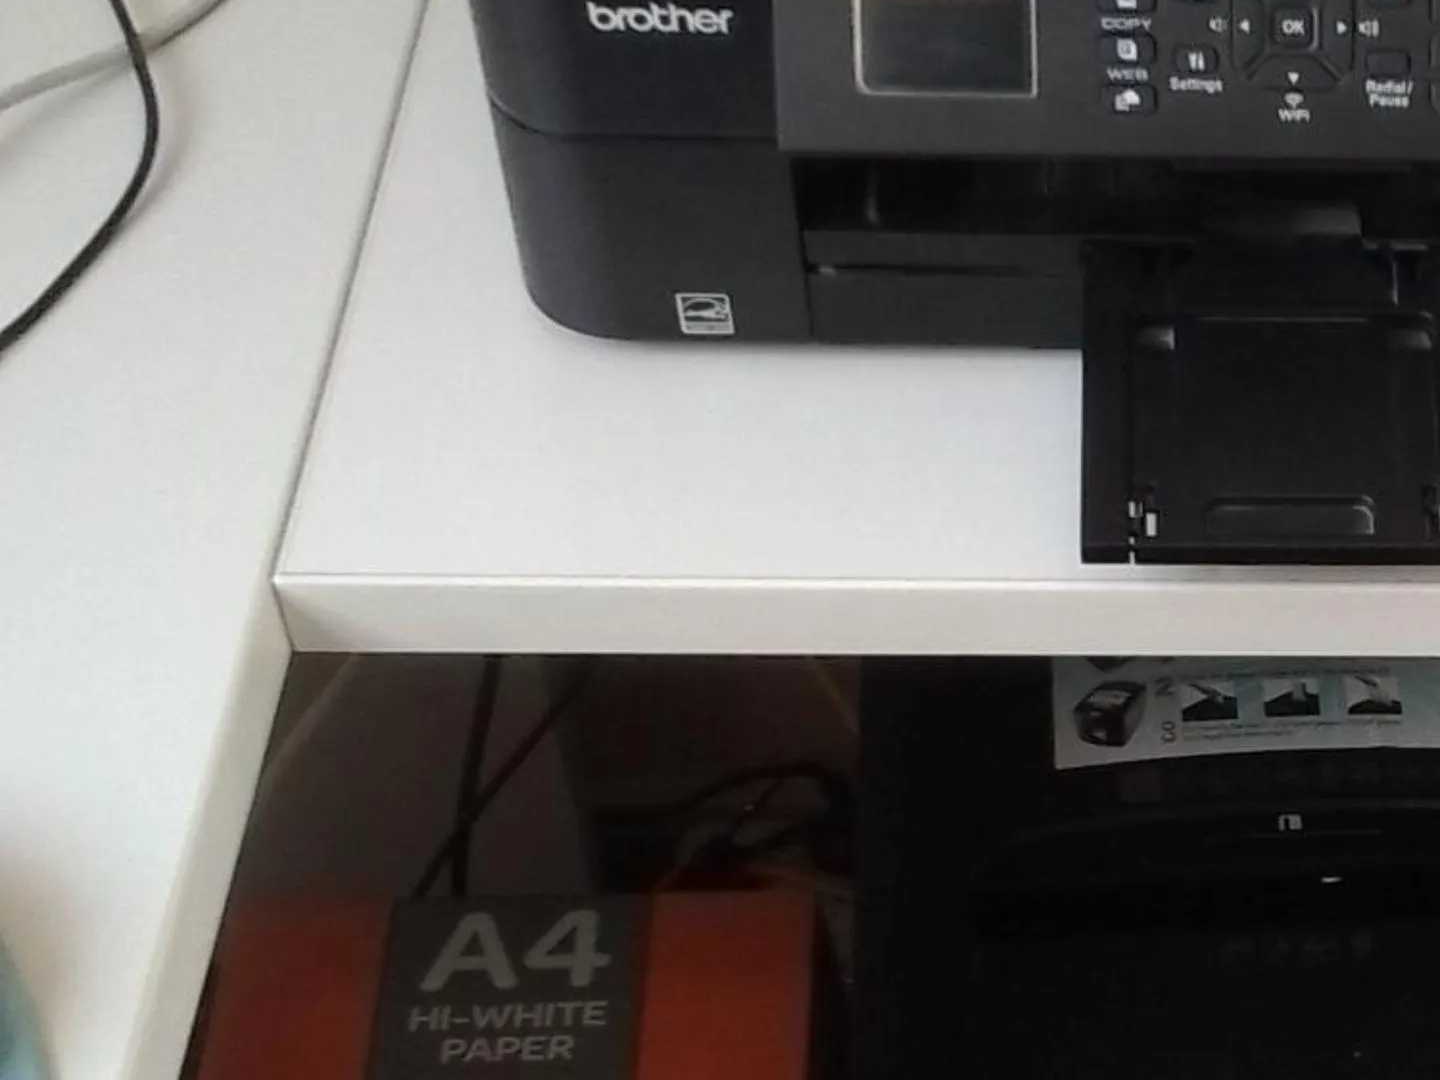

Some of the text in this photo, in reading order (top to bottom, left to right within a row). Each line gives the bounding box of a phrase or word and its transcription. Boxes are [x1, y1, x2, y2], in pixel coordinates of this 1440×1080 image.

[585, 1, 734, 35] brother
[1101, 17, 1151, 32] COPY
[1281, 18, 1304, 34] OK
[1169, 76, 1223, 94] Settings
[1369, 92, 1409, 109] Pause
[420, 909, 612, 992] A4
[408, 1000, 608, 1032] HI-WHITE
[440, 1035, 575, 1064] PAPER
